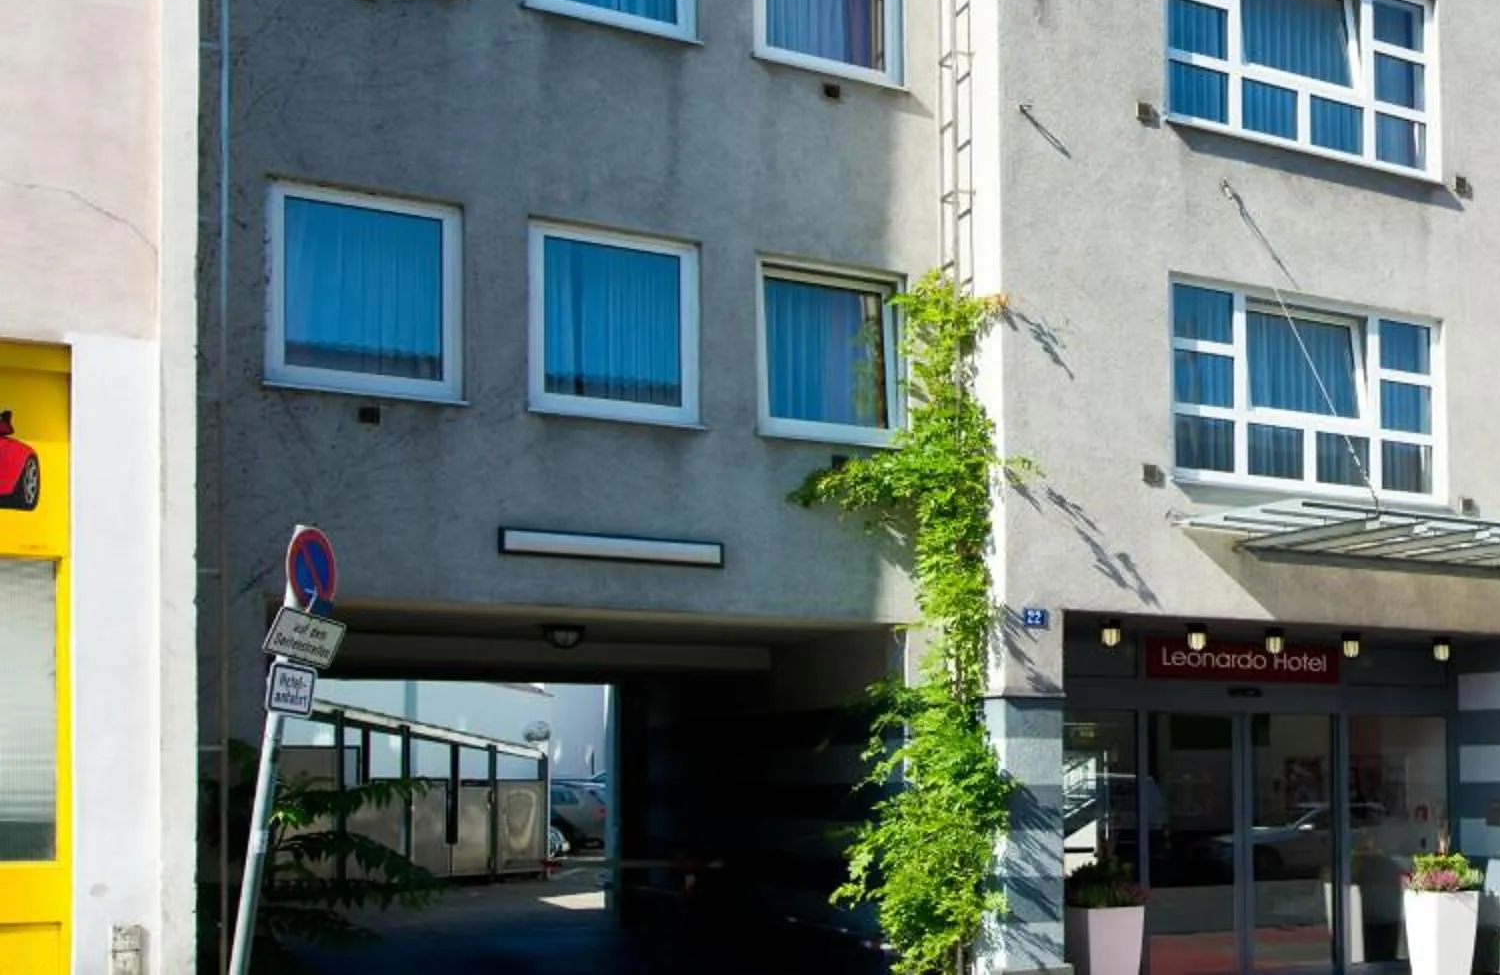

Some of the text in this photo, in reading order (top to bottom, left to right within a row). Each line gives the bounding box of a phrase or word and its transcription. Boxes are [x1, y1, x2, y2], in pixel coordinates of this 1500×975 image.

[1026, 609, 1042, 624] 22
[1161, 646, 1328, 673] Leonardo Hotel
